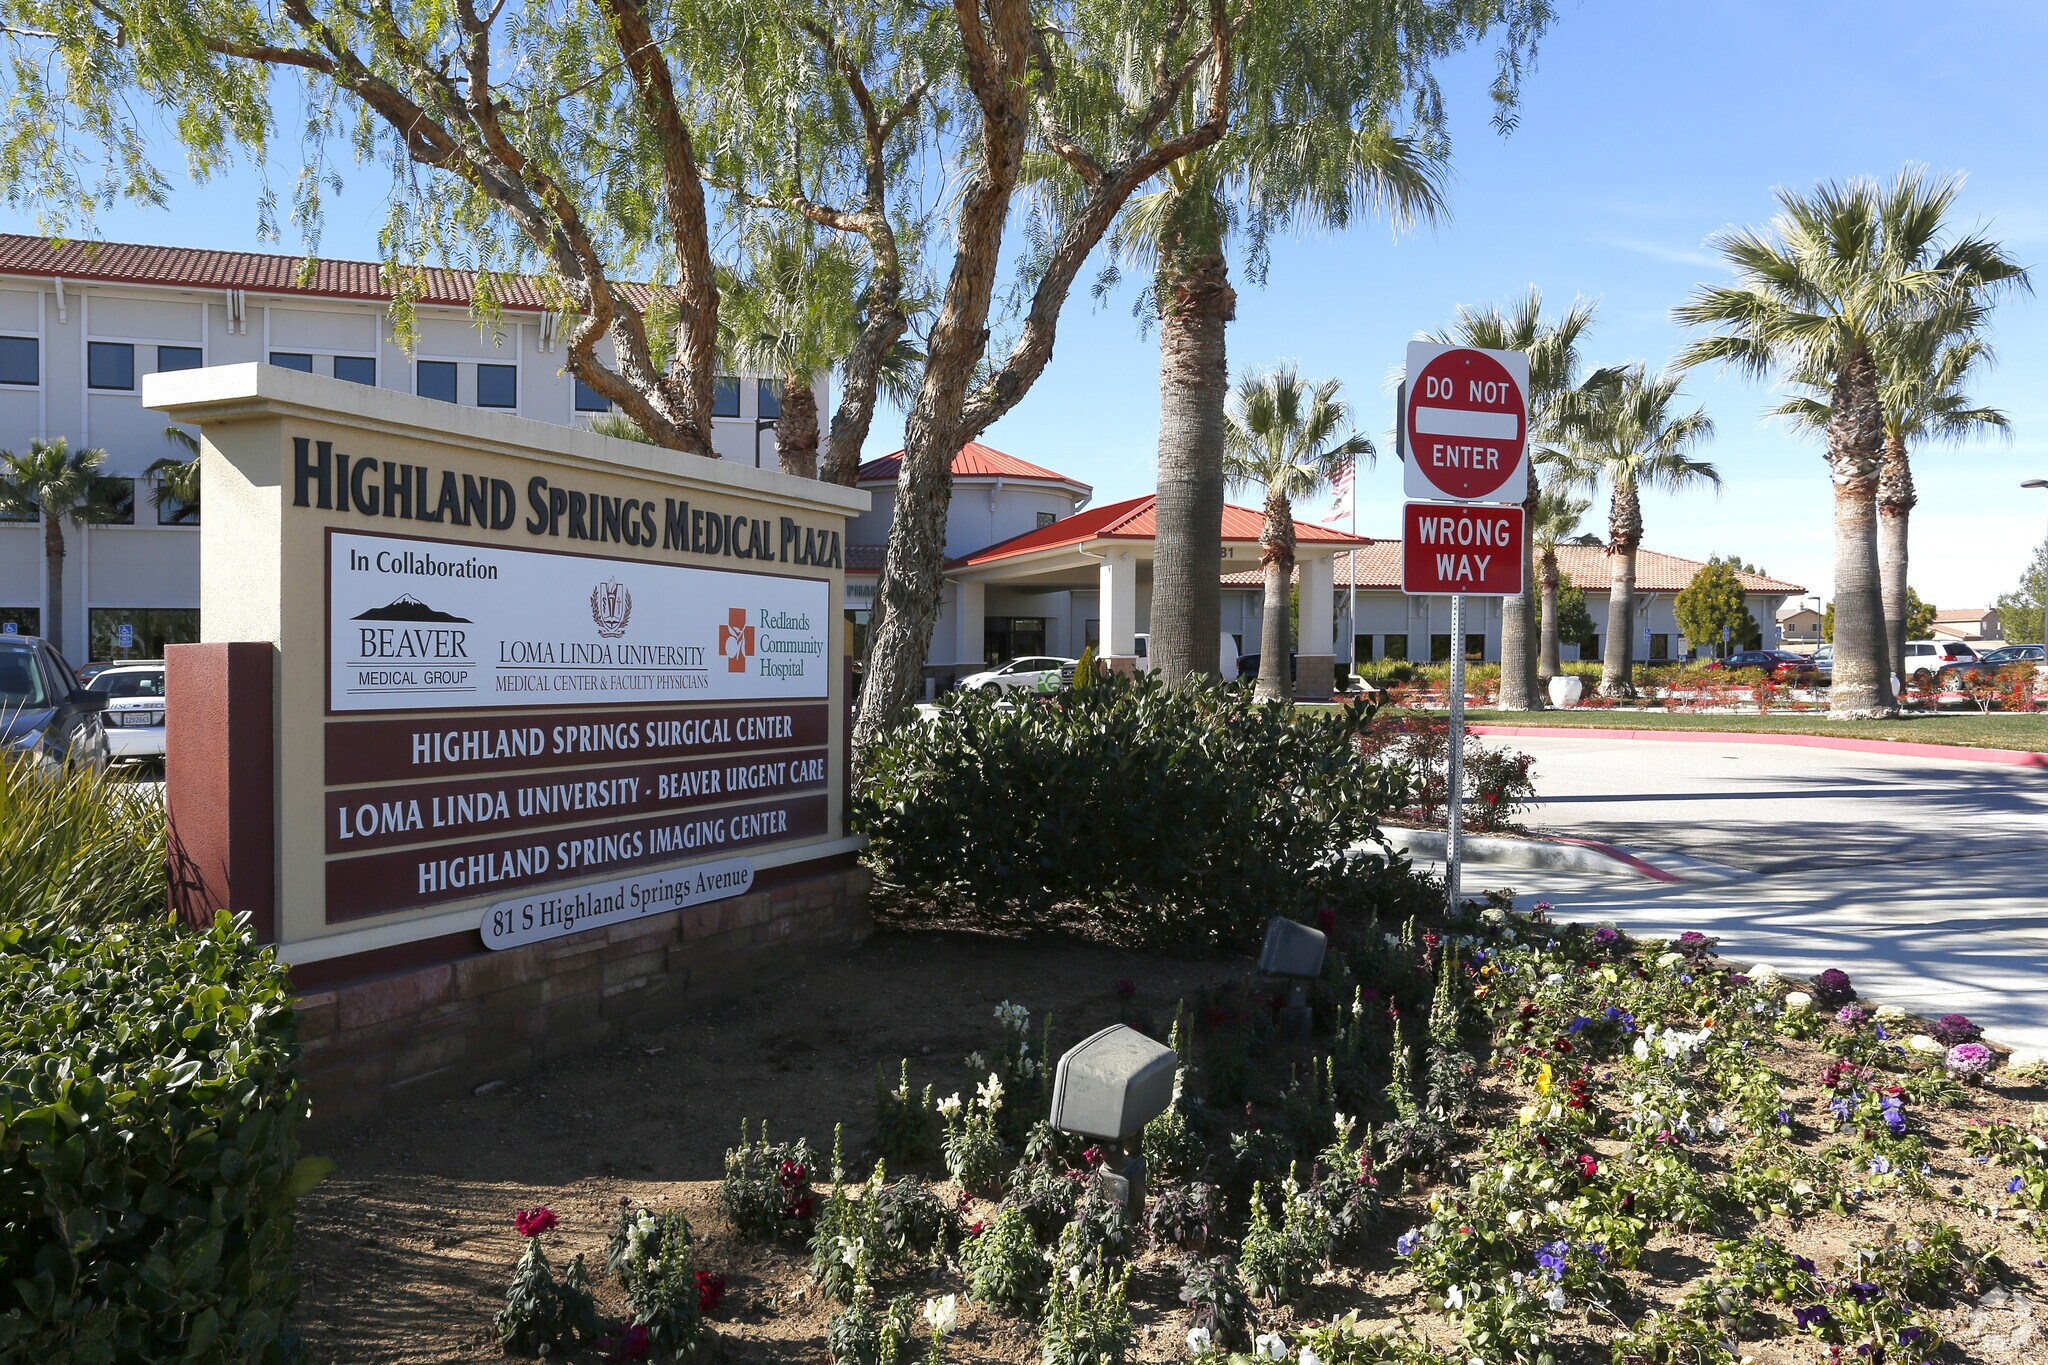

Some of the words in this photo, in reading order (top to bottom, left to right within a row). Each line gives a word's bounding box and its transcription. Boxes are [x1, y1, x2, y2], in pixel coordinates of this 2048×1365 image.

[1426, 375, 1453, 401] DO
[1469, 380, 1509, 404] NOT
[1432, 443, 1499, 470] ENTER
[293, 436, 517, 531] HIGHLAND
[525, 475, 657, 548] SPRINGS
[663, 497, 775, 563] MEDICAL
[780, 516, 843, 570] PLAZA
[1418, 516, 1510, 547] WRONG
[350, 548, 369, 572] In
[376, 550, 498, 580] Collaboration
[1435, 553, 1491, 582] WAY
[759, 608, 810, 631] Redlands
[359, 627, 468, 659] BEAVER
[499, 640, 555, 664] LOMA
[560, 642, 612, 665] LINDA
[617, 643, 706, 666] UNIVERSITY
[759, 633, 824, 658] Community
[358, 671, 417, 686] MEDICAL
[423, 670, 468, 685] GROUP
[495, 675, 551, 692] MEDICAL
[553, 674, 599, 691] CENTER
[599, 676, 608, 690] &
[610, 675, 654, 690] FACULTY
[656, 674, 709, 690] PHYSICIANS
[759, 658, 804, 681] Hospital
[411, 727, 545, 764] HIGHLAND
[552, 722, 640, 755] SPRINGS
[645, 718, 731, 748] SURGICAL
[736, 715, 793, 741] CENTER
[338, 799, 424, 840] LOMA
[432, 790, 511, 828] LINDA
[517, 777, 640, 817] UNIVERSITY
[658, 768, 722, 800] BEAVER
[726, 762, 786, 792] URGENT
[789, 758, 825, 784] CARE
[418, 845, 550, 894] HIGHLAND
[556, 830, 644, 870] SPRINGS
[649, 818, 725, 855] IMAGING
[730, 809, 788, 841] CENTER
[493, 907, 515, 937] 81
[522, 903, 534, 931] S
[539, 885, 625, 930] Highland
[630, 879, 691, 914] Springs
[695, 868, 749, 895] Avenue
